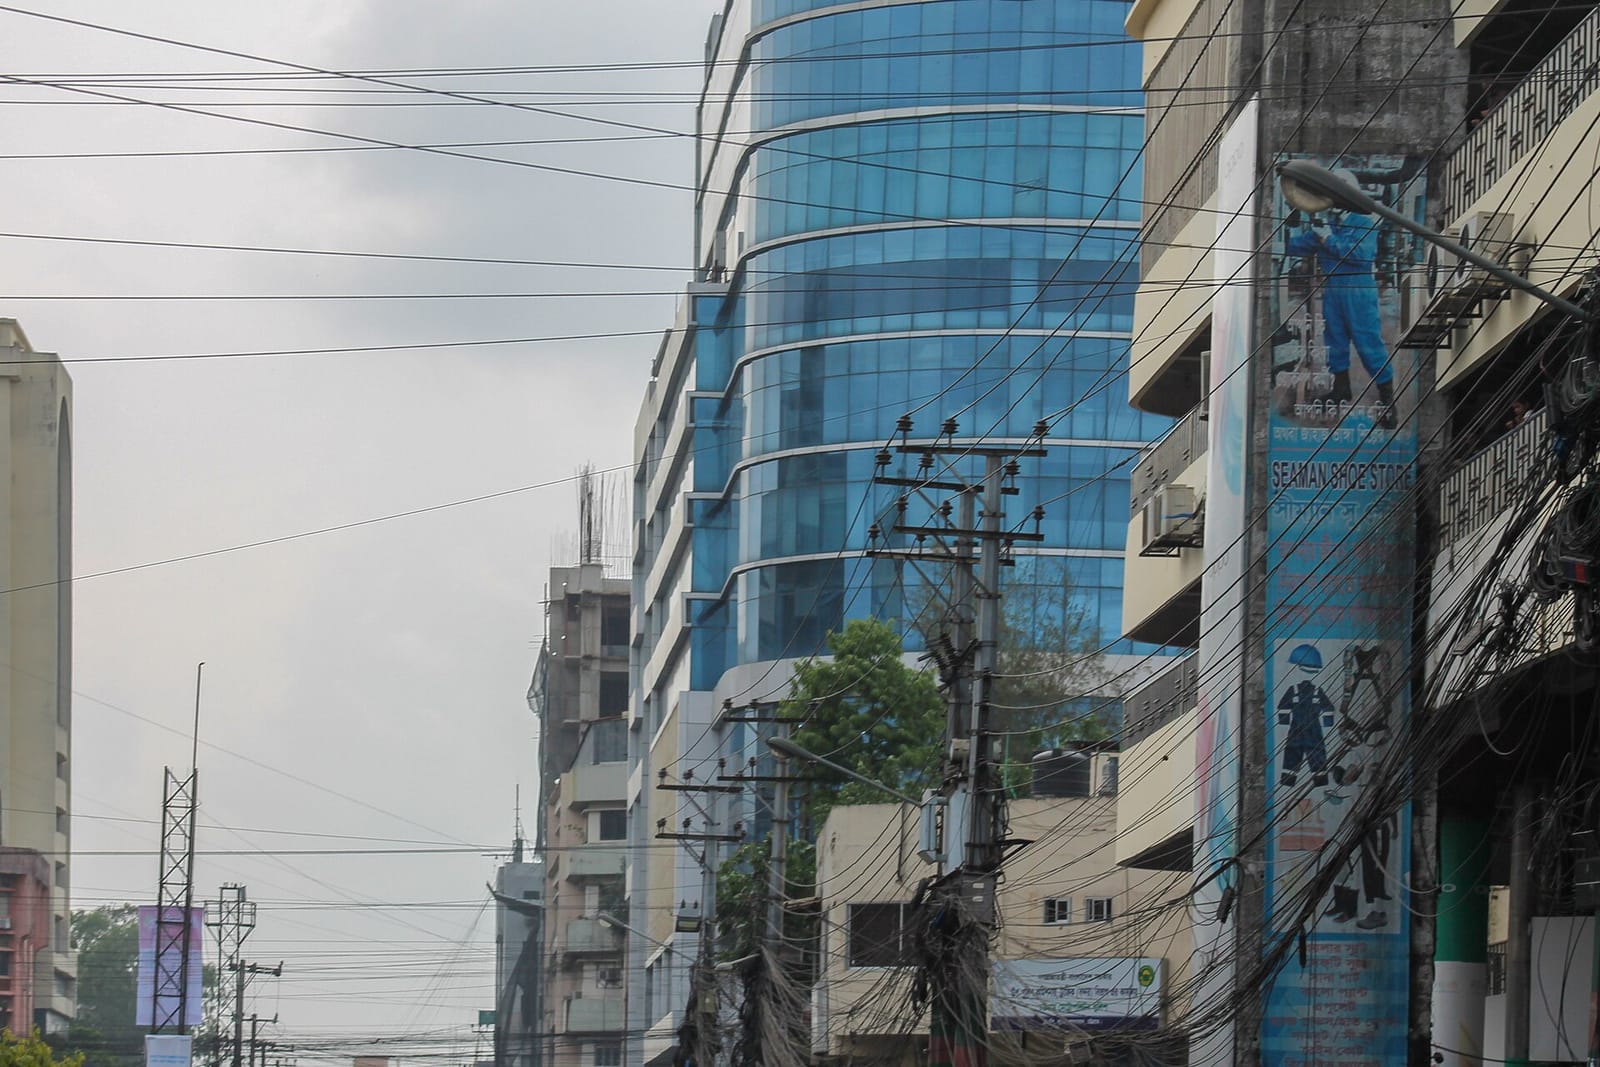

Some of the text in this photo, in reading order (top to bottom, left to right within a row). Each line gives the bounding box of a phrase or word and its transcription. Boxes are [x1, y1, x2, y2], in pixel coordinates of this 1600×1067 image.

[1272, 461, 1412, 491] SEAMAN SHOE STORE
